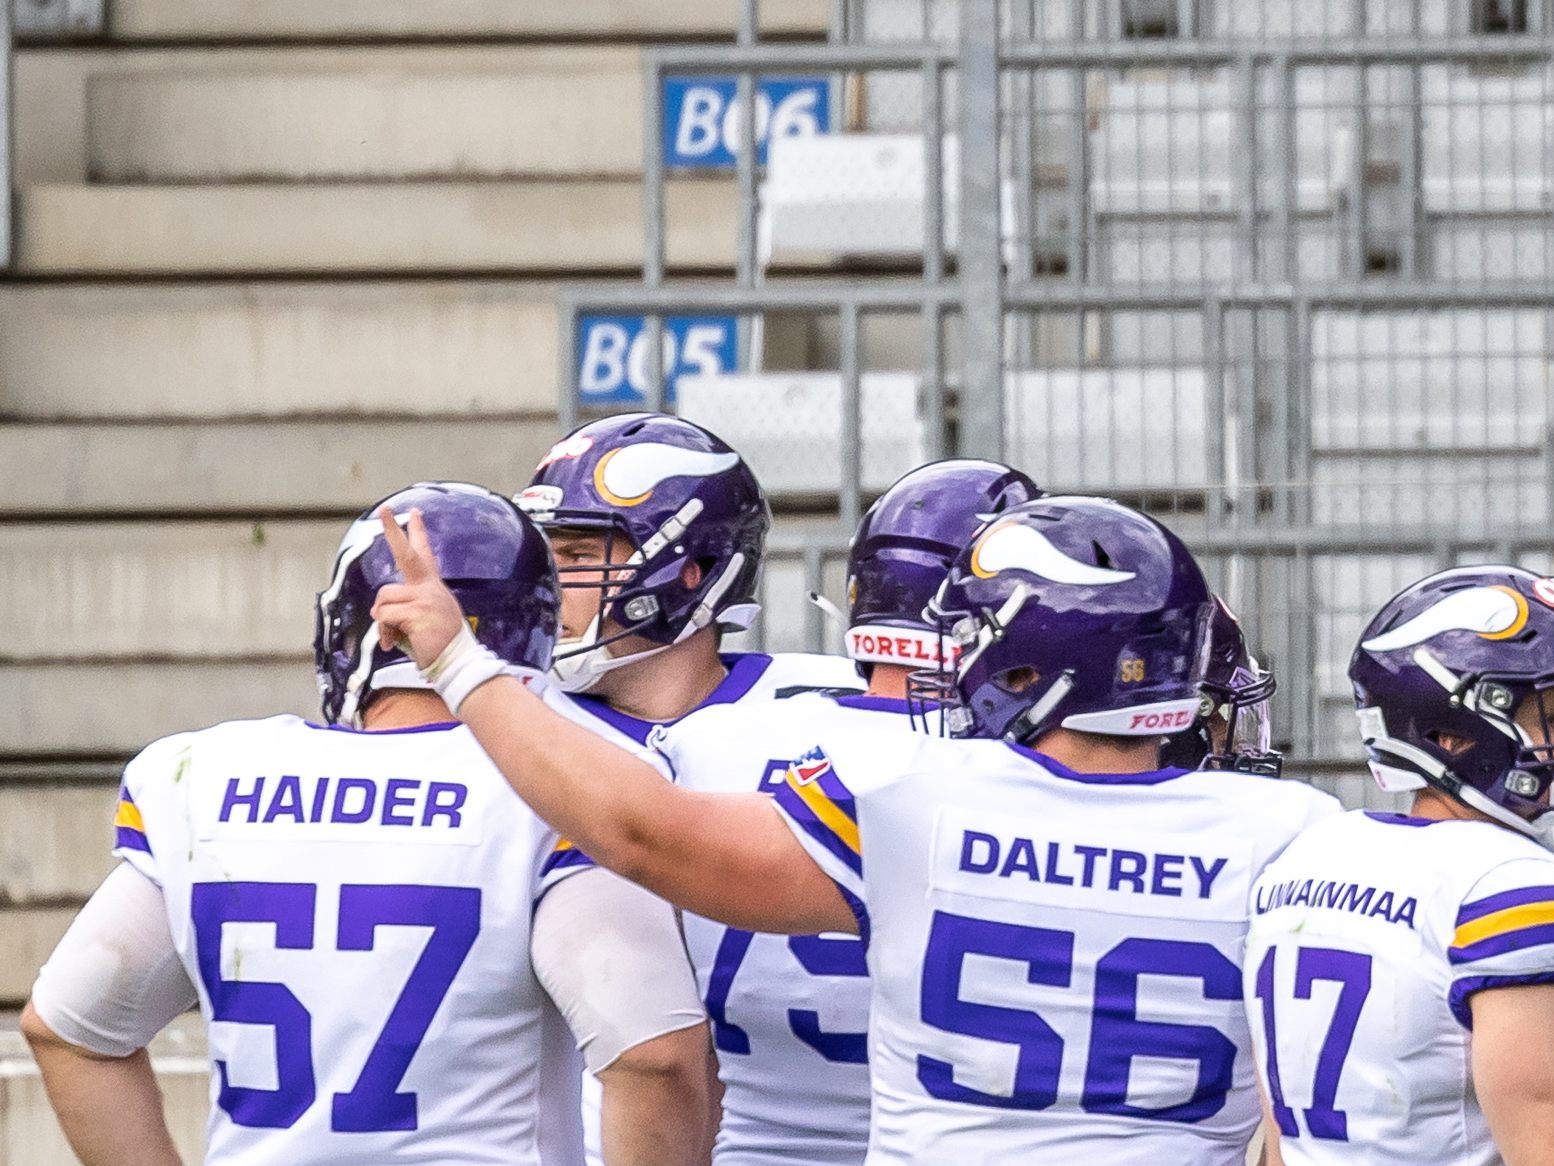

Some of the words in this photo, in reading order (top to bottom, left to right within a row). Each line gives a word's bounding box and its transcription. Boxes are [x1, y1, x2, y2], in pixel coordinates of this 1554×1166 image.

[217, 775, 469, 830] HAIDER
[958, 829, 1230, 899] DALTREY
[190, 881, 482, 1133] 57
[916, 909, 1244, 1123] 56
[1254, 944, 1373, 1143] 17
